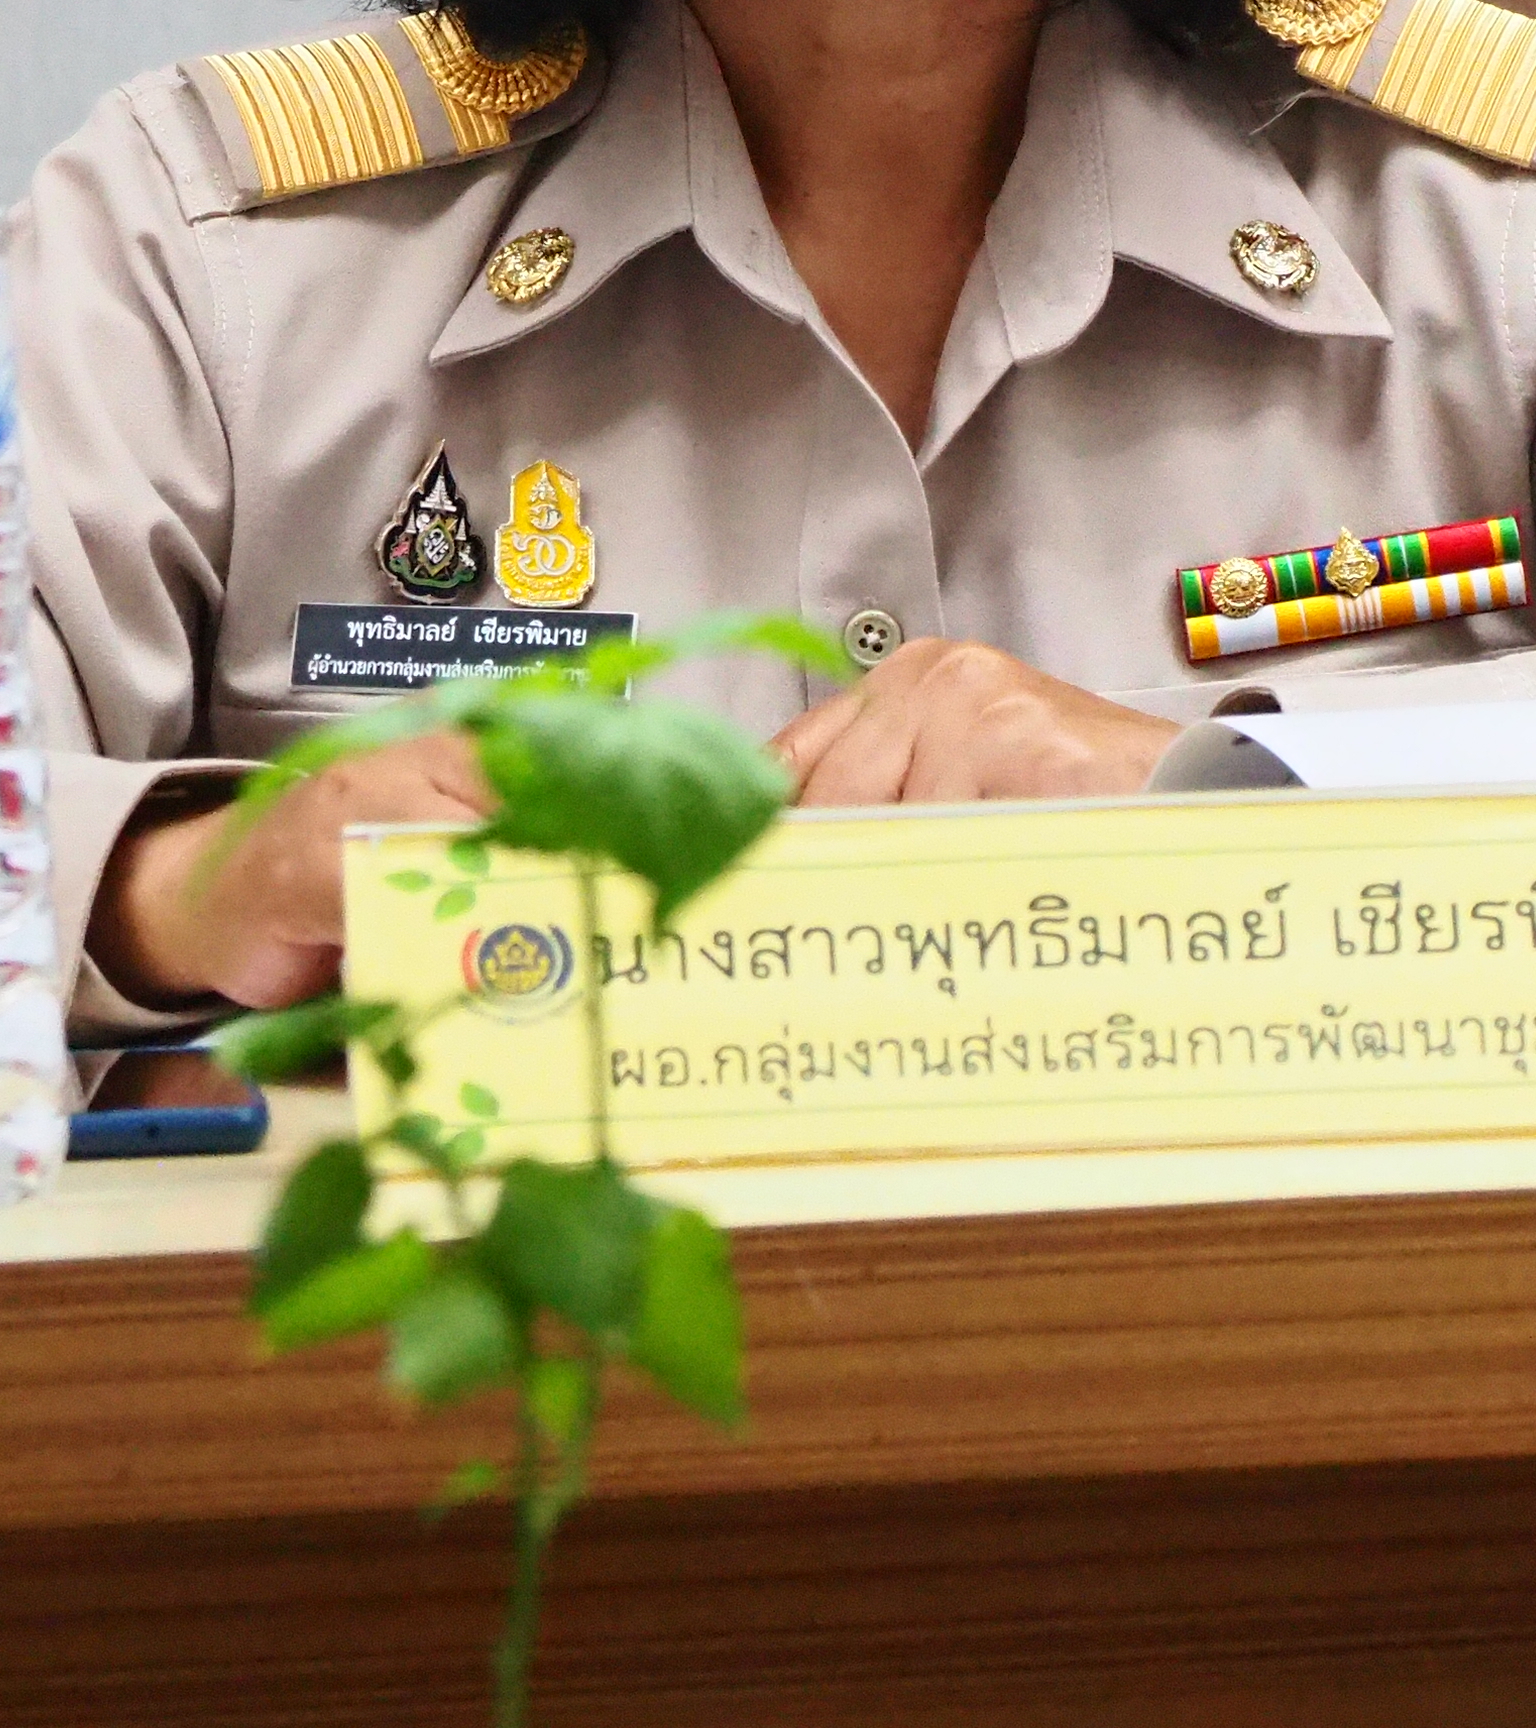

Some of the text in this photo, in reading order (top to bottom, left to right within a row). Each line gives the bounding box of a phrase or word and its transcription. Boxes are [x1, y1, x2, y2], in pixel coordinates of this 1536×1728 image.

[347, 615, 459, 648] พุทธิมาลย์
[591, 881, 1291, 999] นางสาวพุทธิมาลย์
